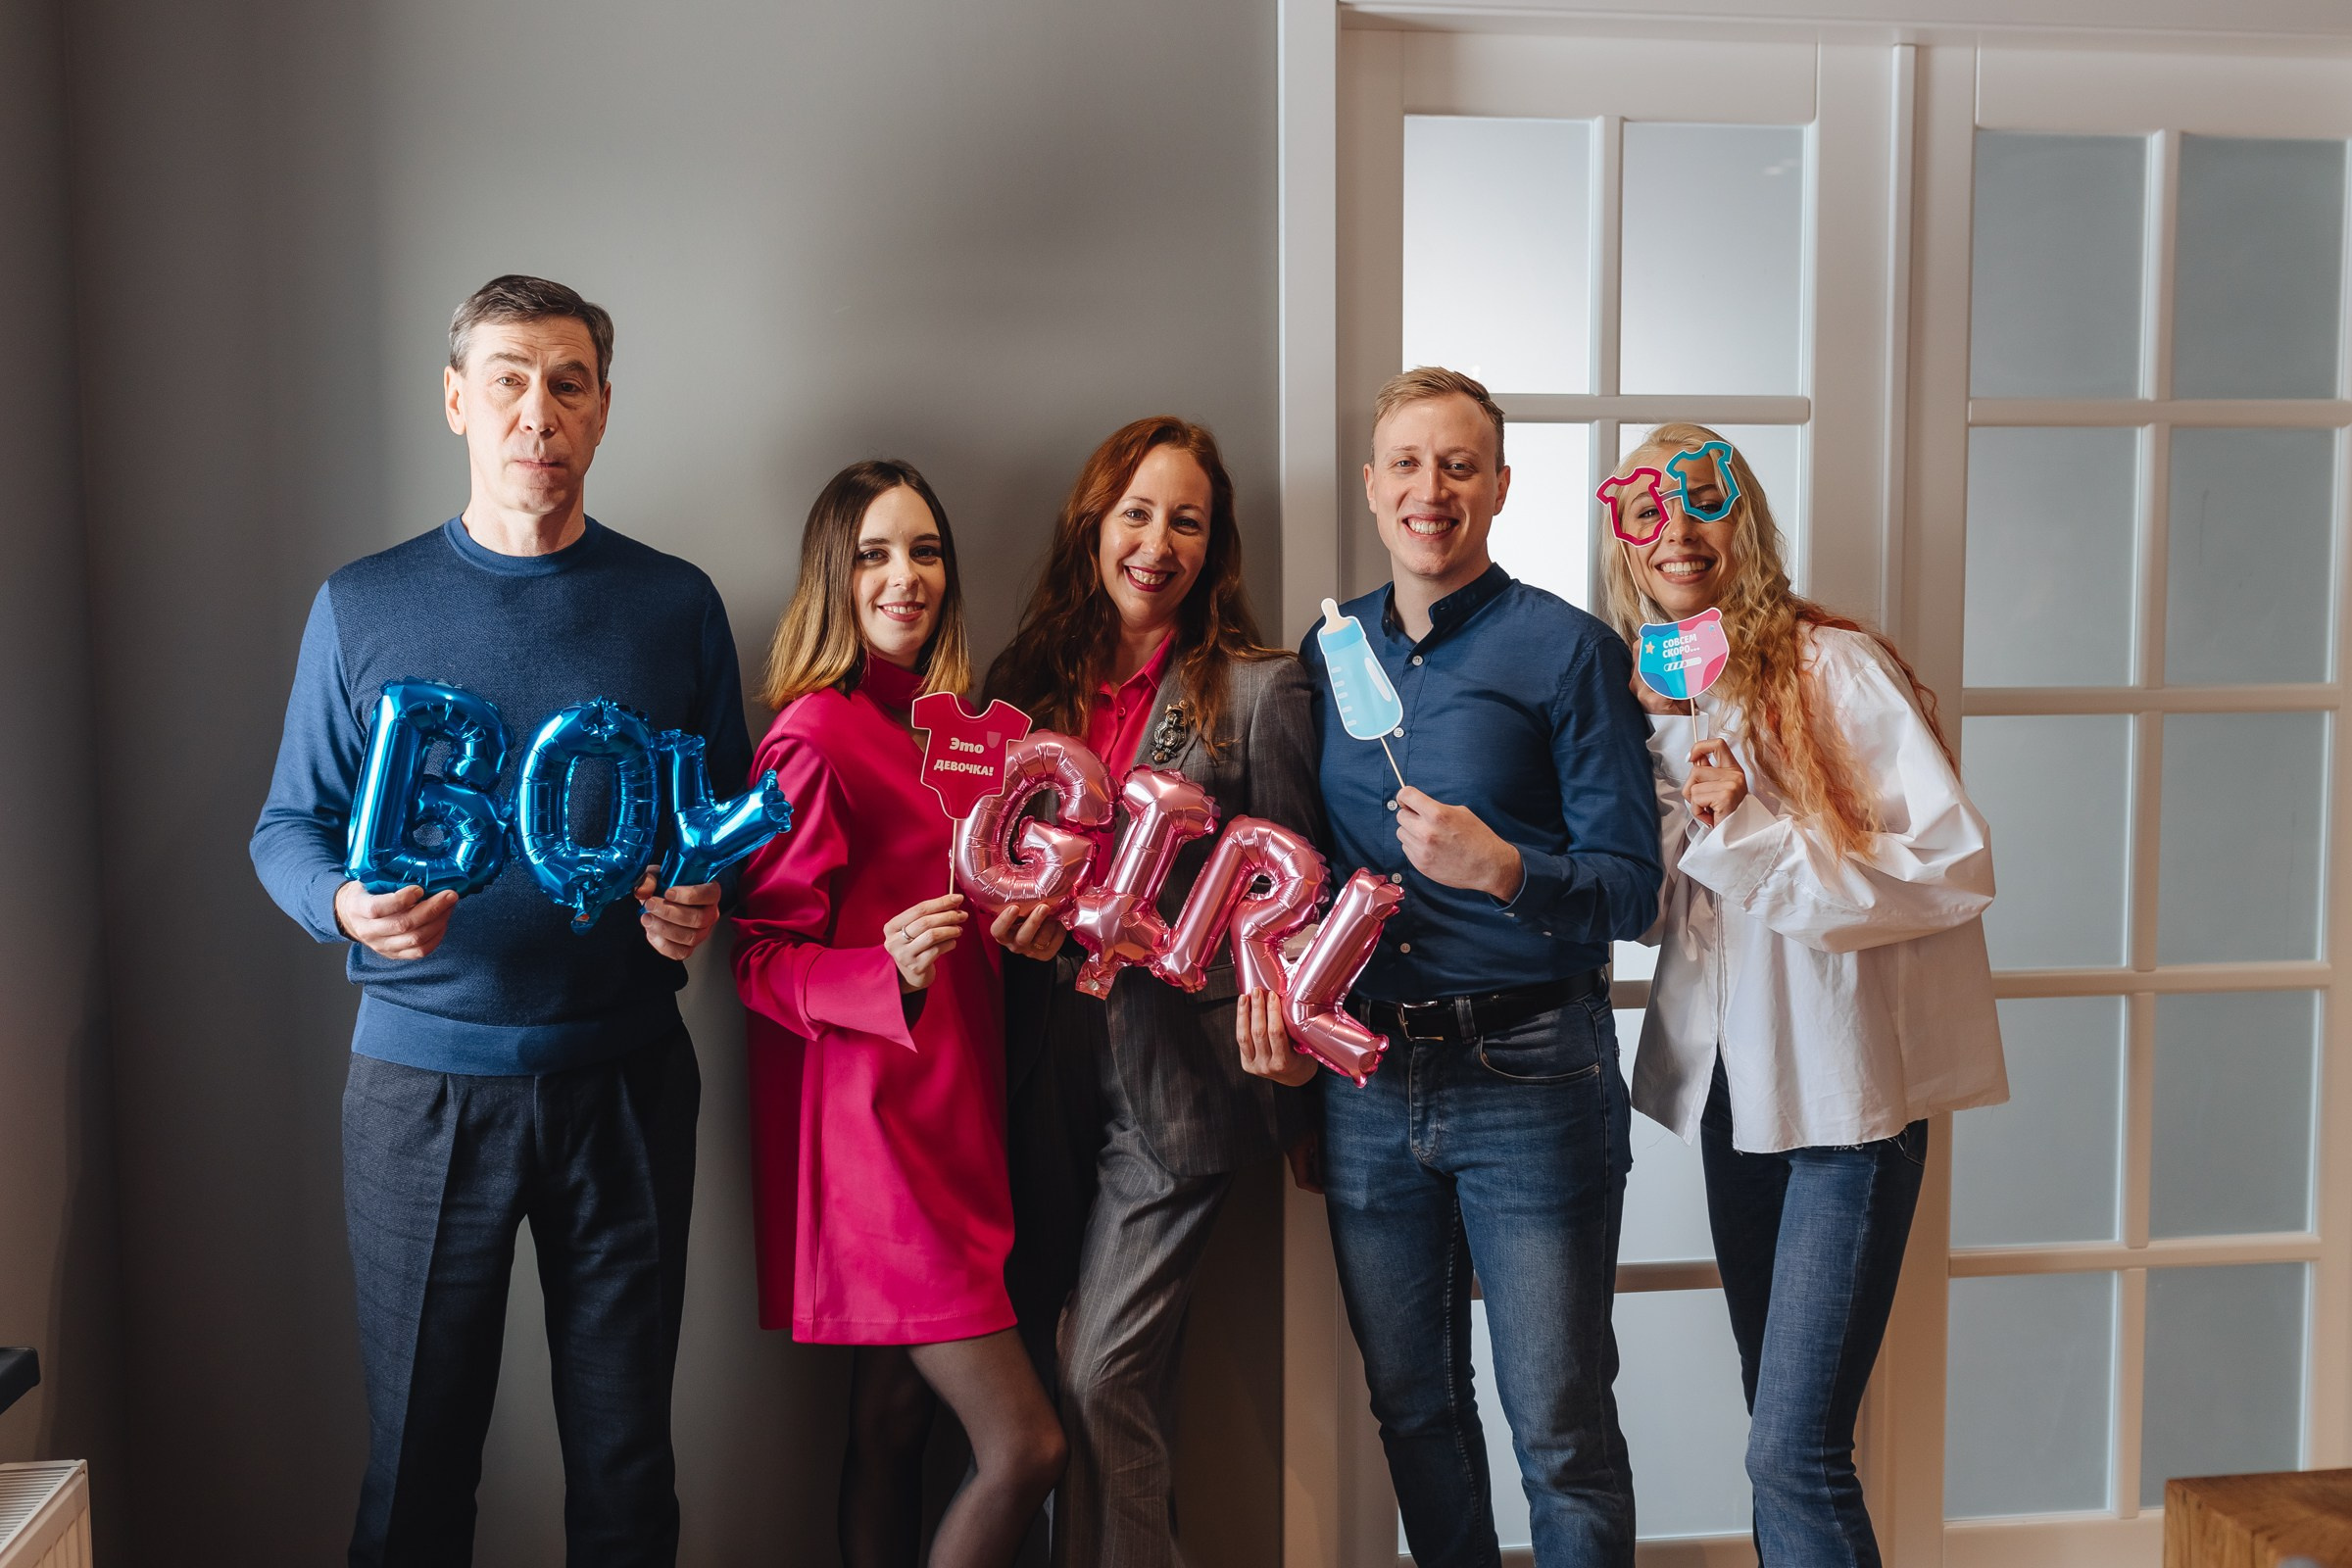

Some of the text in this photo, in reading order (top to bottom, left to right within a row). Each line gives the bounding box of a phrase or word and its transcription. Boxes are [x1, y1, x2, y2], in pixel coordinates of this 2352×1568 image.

[1662, 633, 1697, 649] СОВСЕМ
[1662, 644, 1700, 659] СКОРО...
[949, 737, 985, 754] Это
[933, 760, 995, 776] ДЕВОЧКА!
[345, 676, 794, 931] BOY
[951, 729, 1406, 1088] GIRL
